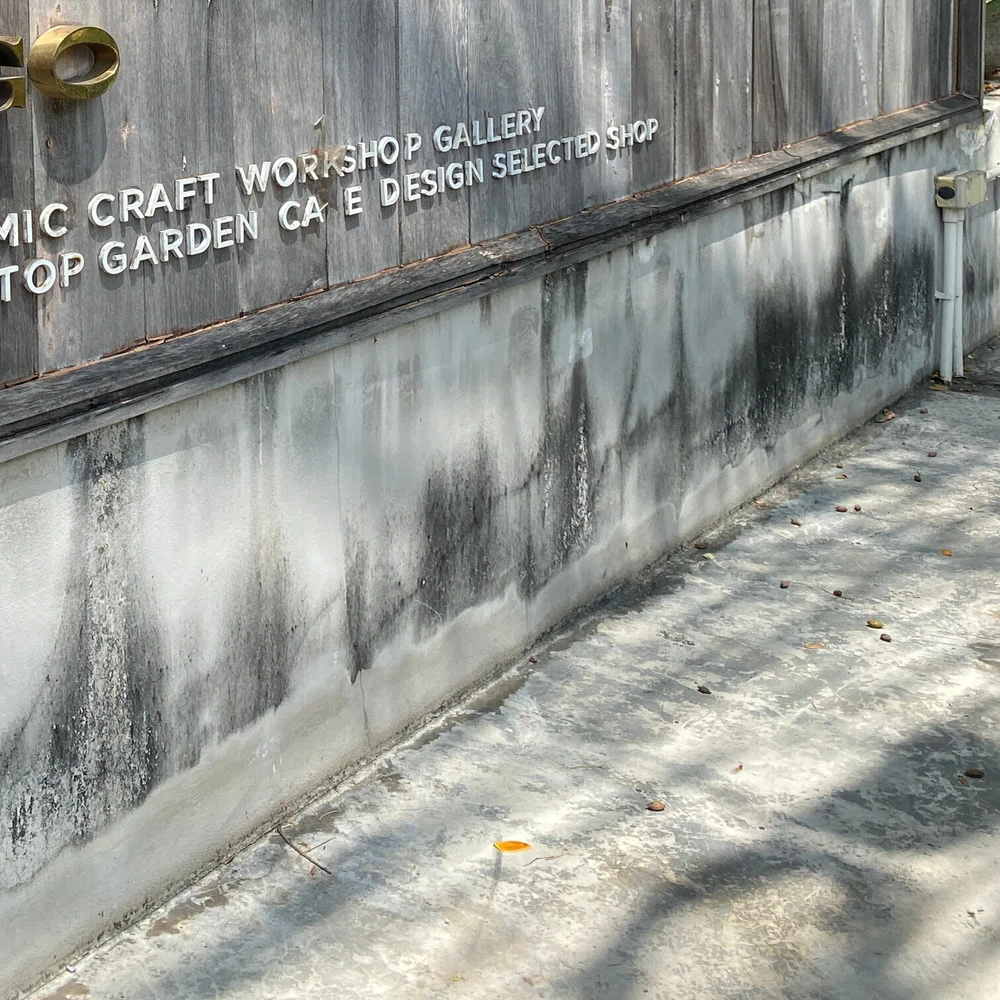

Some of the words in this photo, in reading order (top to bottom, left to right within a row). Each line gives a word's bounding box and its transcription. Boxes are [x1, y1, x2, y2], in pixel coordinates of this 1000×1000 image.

[87, 172, 221, 227] CRAFT
[234, 132, 422, 195] WORKSHOP
[433, 106, 545, 152] GALLERY
[98, 210, 259, 275] GARDEN
[380, 157, 484, 207] DESIGN
[492, 130, 601, 179] SELECTED
[606, 117, 659, 151] SHOP
